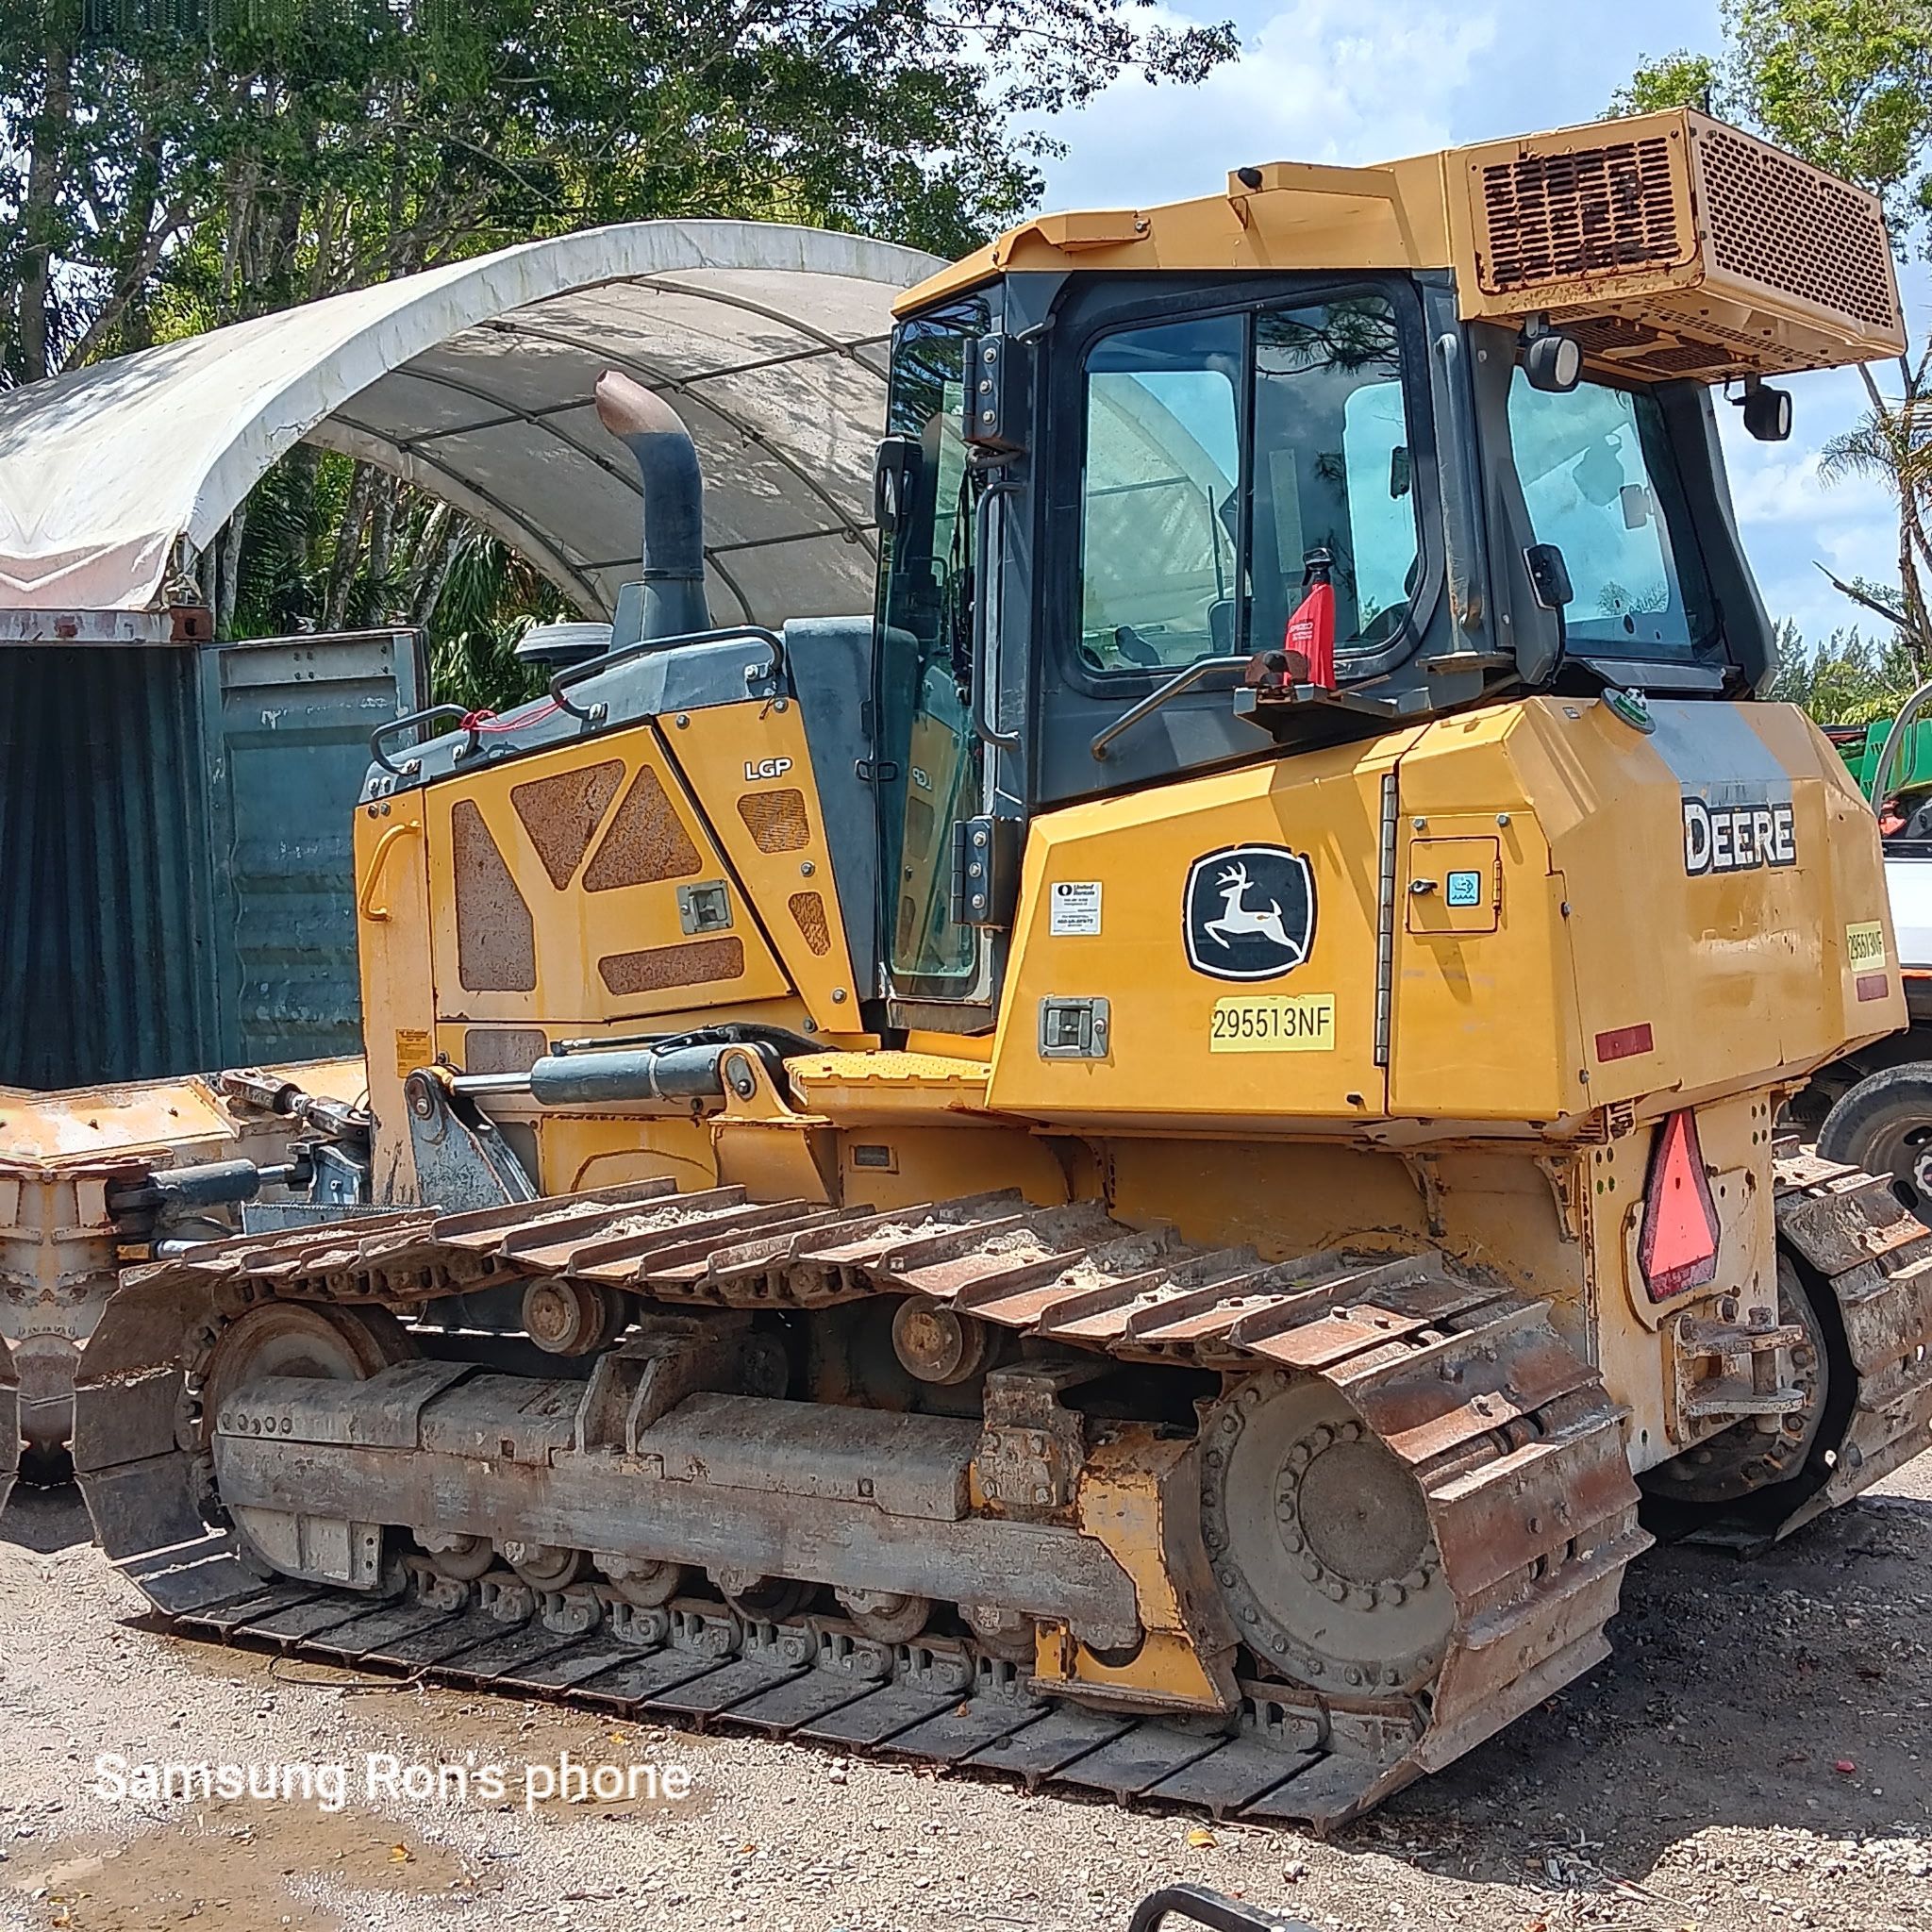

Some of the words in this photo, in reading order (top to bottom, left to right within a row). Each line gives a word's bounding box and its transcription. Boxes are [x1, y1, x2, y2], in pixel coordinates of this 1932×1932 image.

[744, 758, 792, 781] LGP
[1682, 799, 1796, 874] DEERE
[1213, 1007, 1331, 1039] 295513NF
